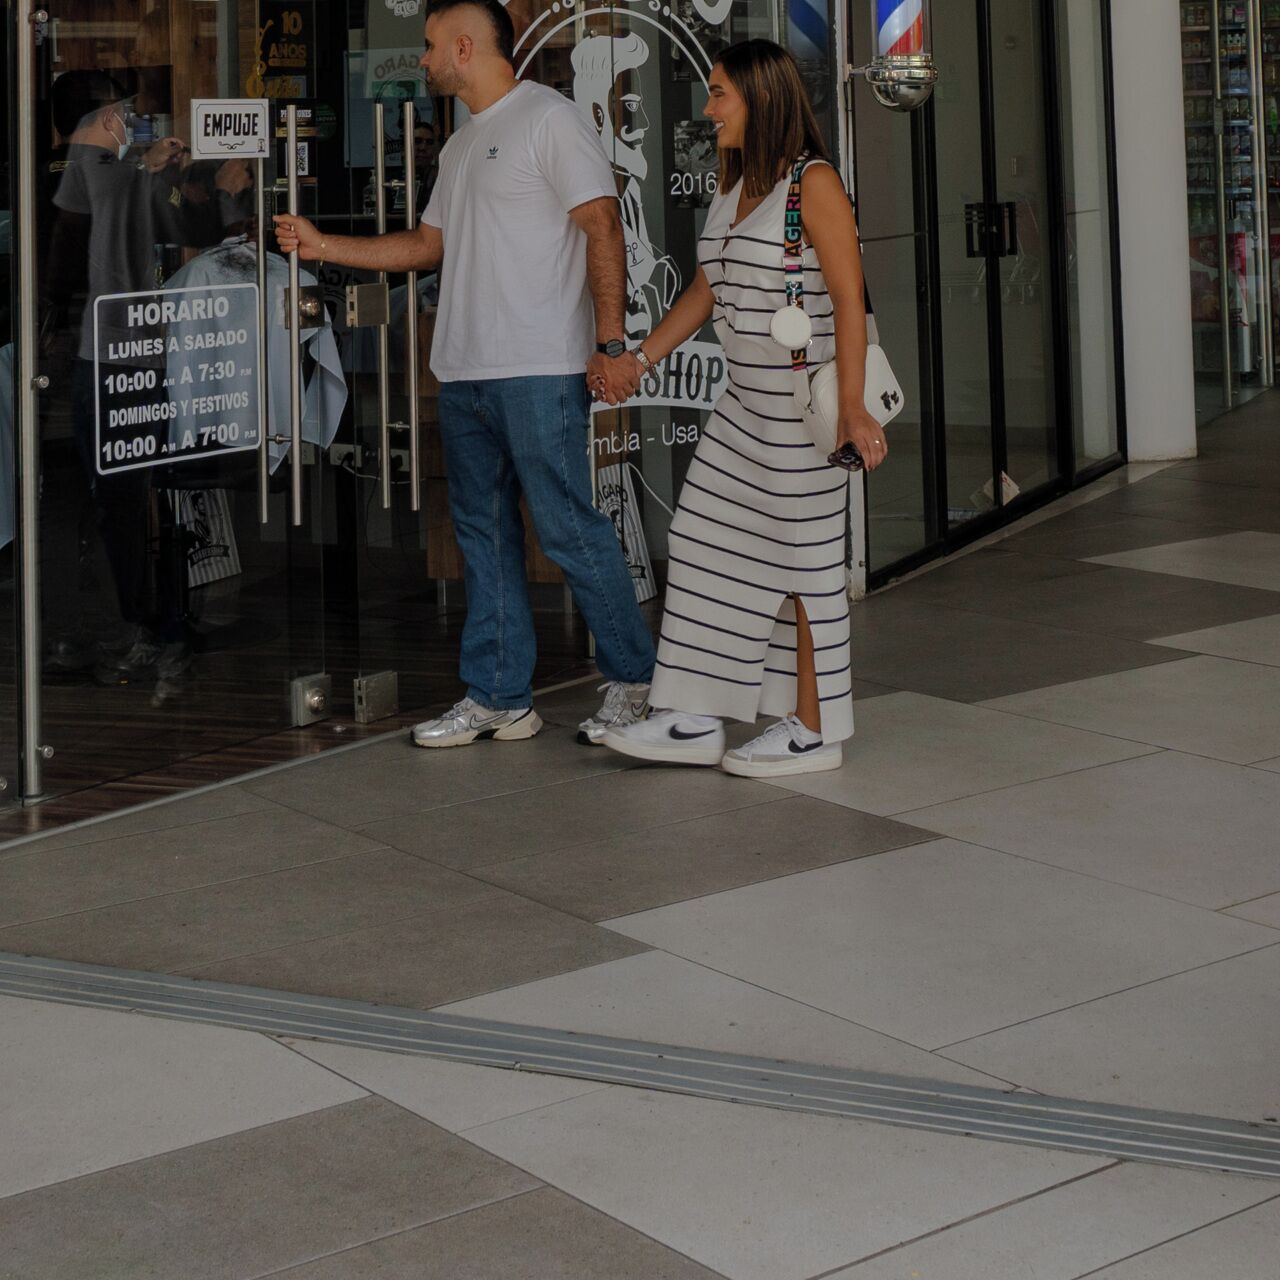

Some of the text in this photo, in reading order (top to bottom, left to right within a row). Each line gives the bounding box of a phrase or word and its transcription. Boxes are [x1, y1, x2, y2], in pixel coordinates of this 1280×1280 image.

[280, 8, 304, 36] 10
[268, 37, 307, 58] AÑOS
[203, 111, 260, 138] EMPUJE
[670, 172, 717, 196] 2016
[127, 296, 230, 328] HORARIO
[108, 328, 249, 361] LUNES A SABADO
[104, 368, 157, 394] 10:00
[162, 377, 176, 387] AM
[180, 365, 194, 385] A
[197, 359, 237, 383] 7:30
[109, 391, 249, 429] DOMINGOS Y FESTIVOS
[102, 435, 157, 463] 10:00
[160, 442, 177, 454] AM
[181, 430, 197, 451] A
[199, 421, 240, 447] 7:00
[587, 430, 641, 457] mbia
[661, 423, 700, 447] Usa
